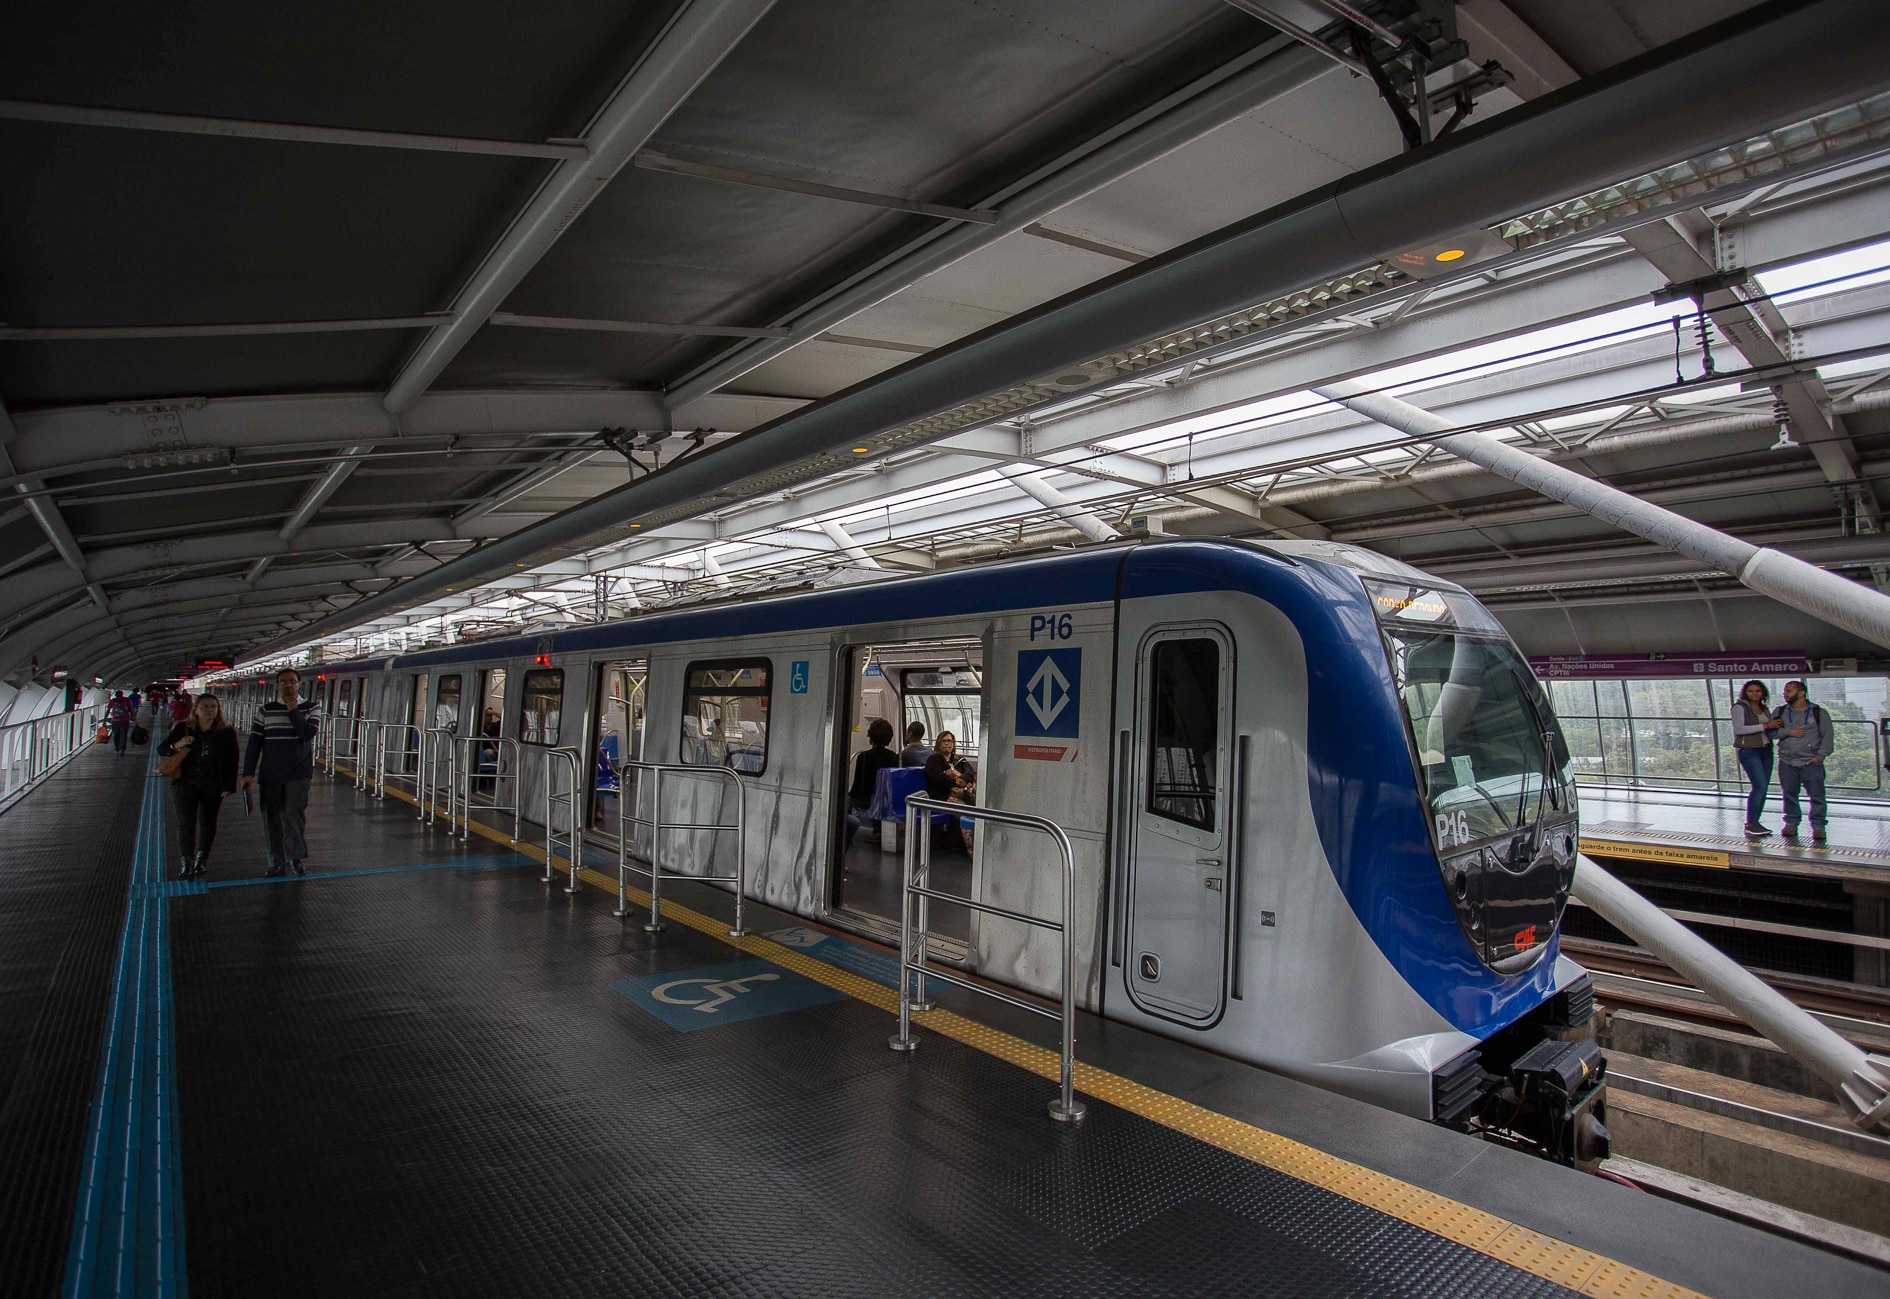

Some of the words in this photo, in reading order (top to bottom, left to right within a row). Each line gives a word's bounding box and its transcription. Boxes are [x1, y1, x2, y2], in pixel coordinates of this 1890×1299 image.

[1029, 613, 1073, 642] P16
[1562, 663, 1588, 671] Nações
[1708, 662, 1747, 673] Santo
[1751, 662, 1798, 672] Amaro
[1435, 809, 1470, 850] P16
[1686, 853, 1718, 861] amarela
